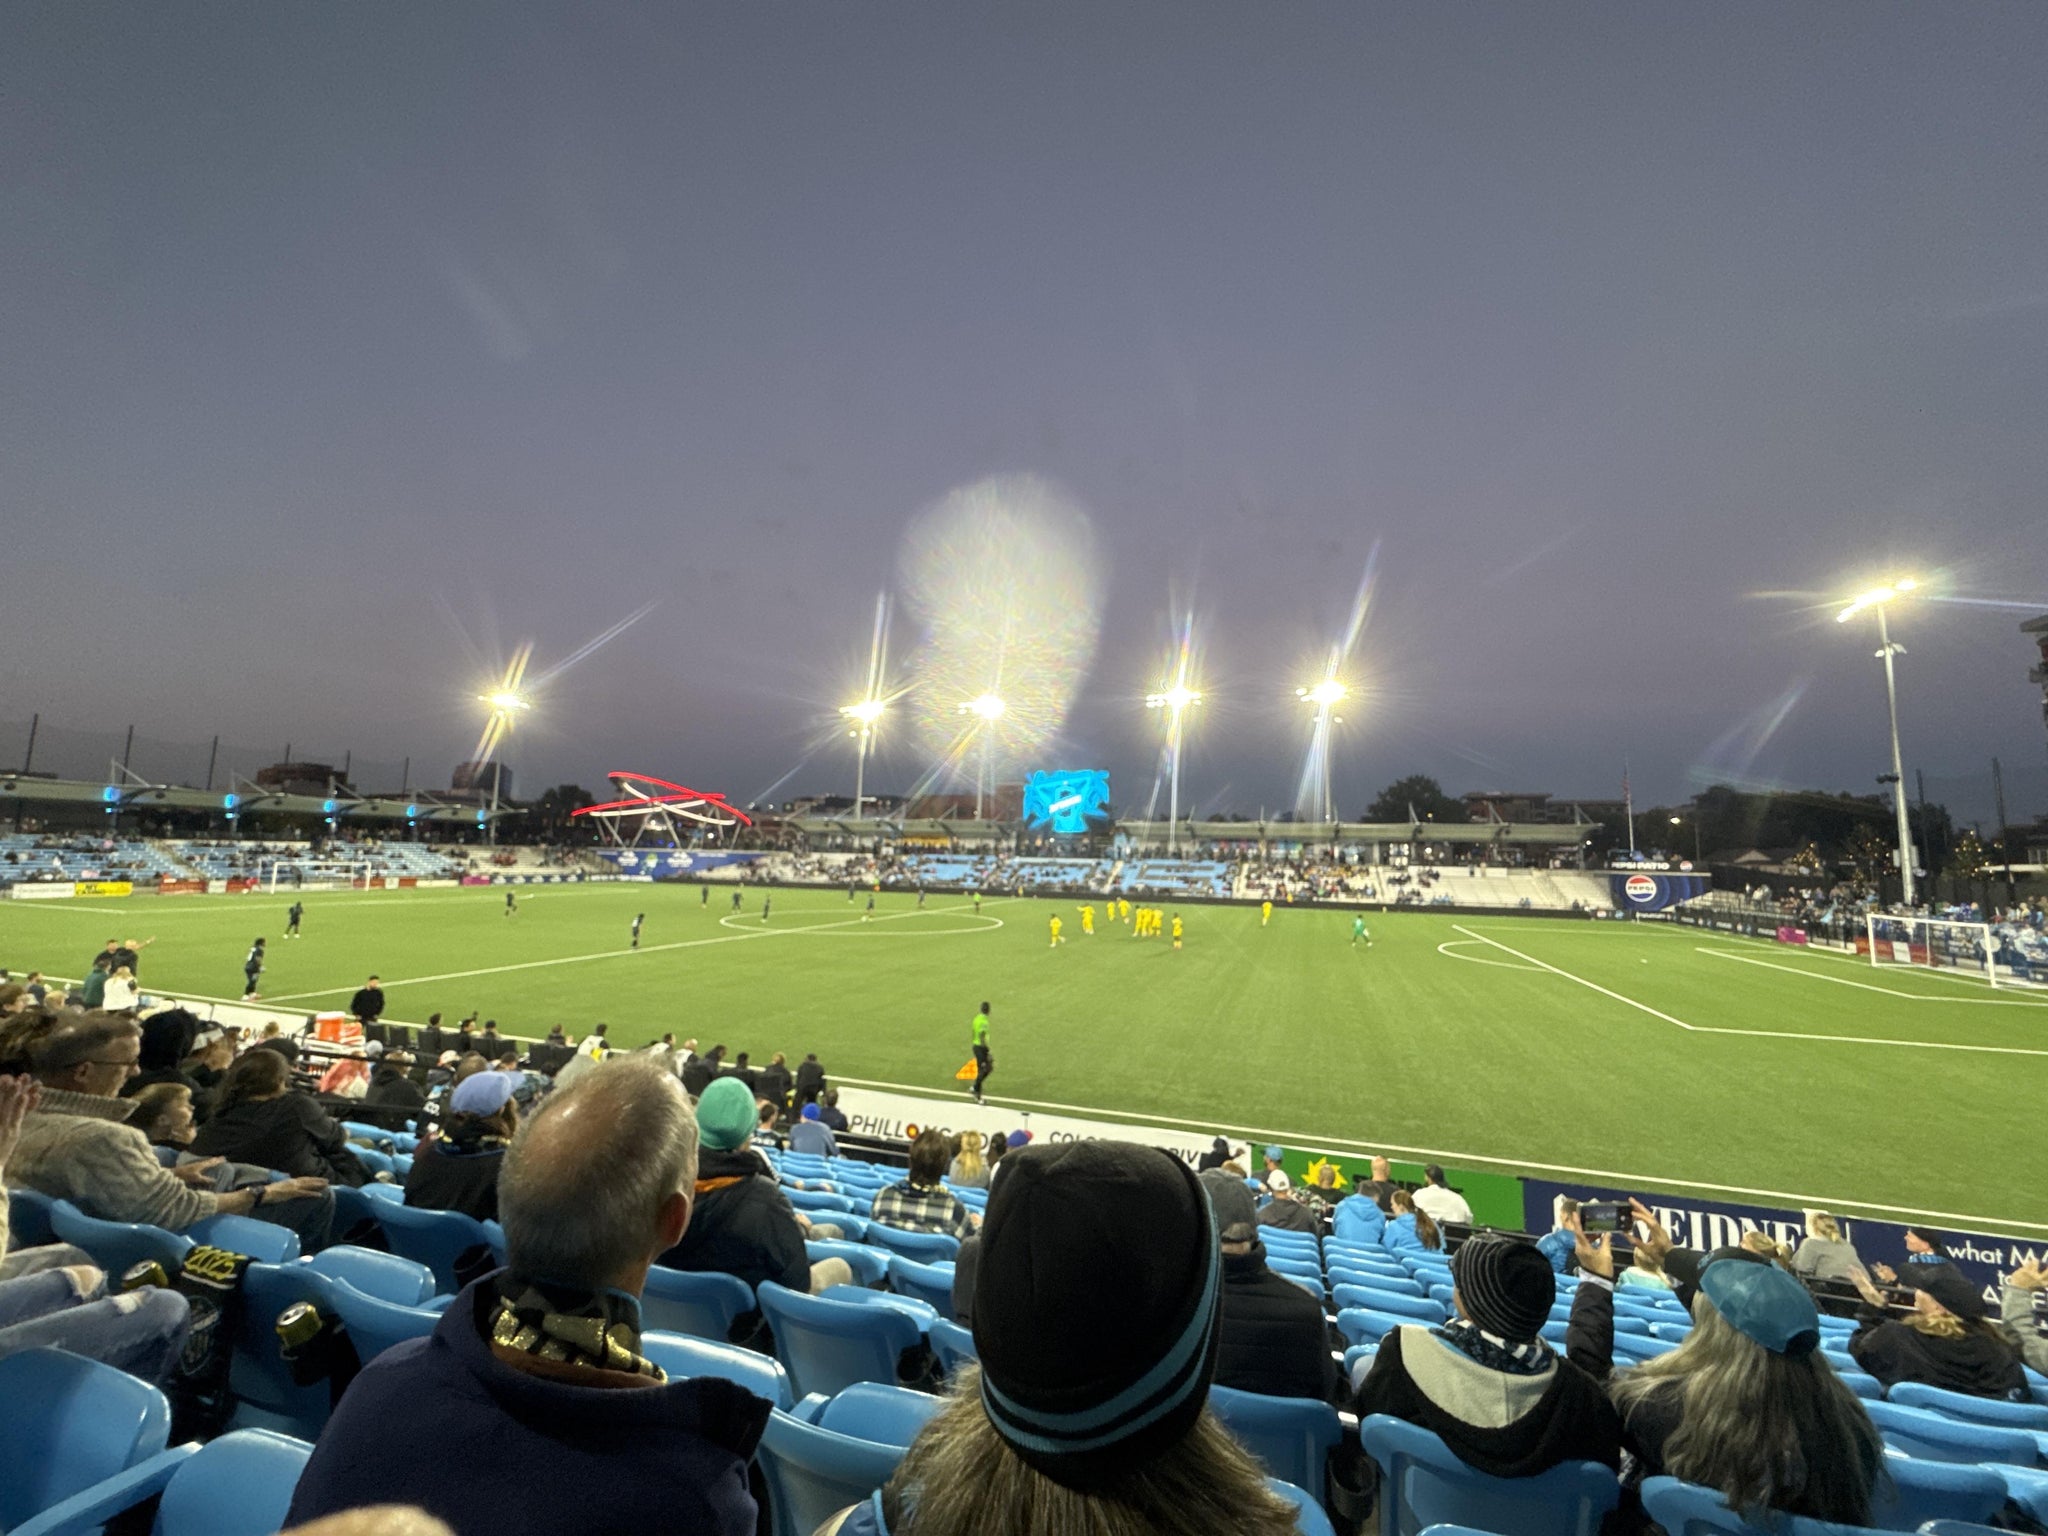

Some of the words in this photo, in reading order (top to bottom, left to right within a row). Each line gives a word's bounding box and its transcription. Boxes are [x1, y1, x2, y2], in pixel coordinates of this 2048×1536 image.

[1627, 884, 1654, 892] PEPSI
[184, 1245, 248, 1280] 2025
[1946, 1240, 2003, 1264] what
